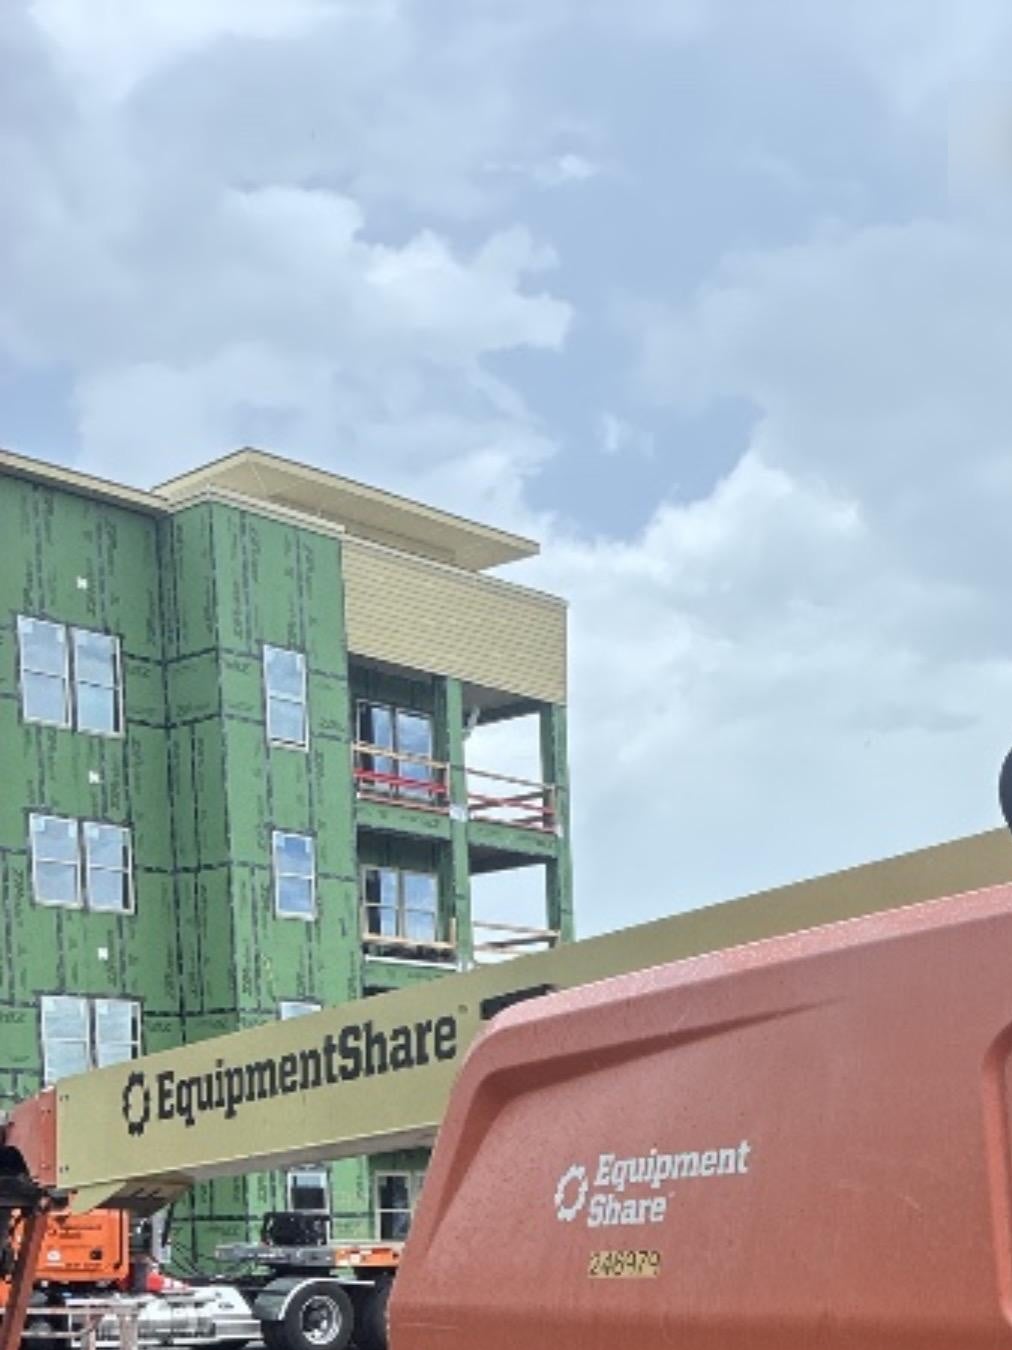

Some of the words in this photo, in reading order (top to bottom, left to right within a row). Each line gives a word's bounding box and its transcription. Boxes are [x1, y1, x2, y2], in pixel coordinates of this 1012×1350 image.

[156, 1014, 458, 1128] EquipmentShare
[593, 1139, 752, 1192] Equipment
[587, 1193, 667, 1228] Share
